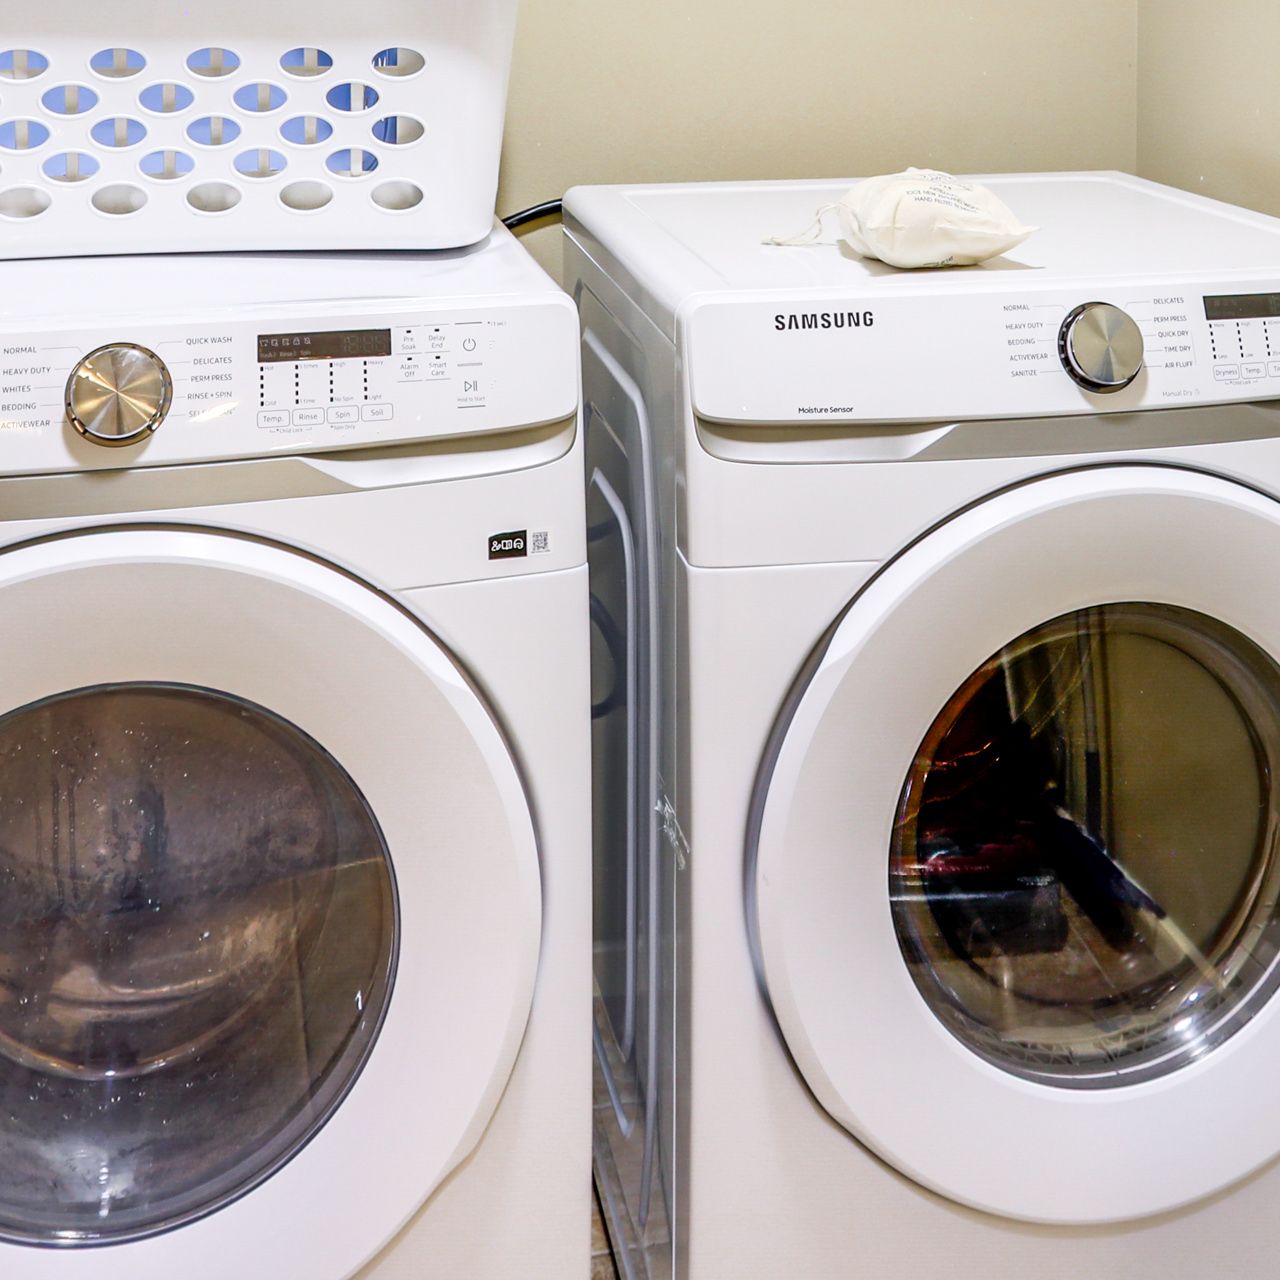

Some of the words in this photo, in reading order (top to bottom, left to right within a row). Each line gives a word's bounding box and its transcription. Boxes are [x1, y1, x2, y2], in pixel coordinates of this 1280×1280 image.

[1153, 297, 1184, 305] DELICATES
[774, 311, 874, 331] SAMSUNG
[186, 338, 208, 346] QUICK
[210, 336, 232, 344] WASH
[1008, 338, 1036, 346] BEDDING
[3, 346, 37, 355] NORMAL
[193, 357, 232, 365] DELICATES
[1009, 353, 1048, 362] ACTIVEWEAR
[2, 368, 28, 376] HEAVY
[30, 366, 51, 374] DUTY
[1011, 369, 1038, 377] SANITIZE
[211, 373, 232, 381] PRESS
[2, 385, 31, 393] WHITES
[187, 392, 208, 400] RINSE
[1, 402, 37, 411] BEDDING
[798, 406, 829, 414] Moisture
[263, 415, 284, 423] Temp.
[335, 411, 350, 419] Spin
[1, 419, 50, 429] ACTIVEWEAR
